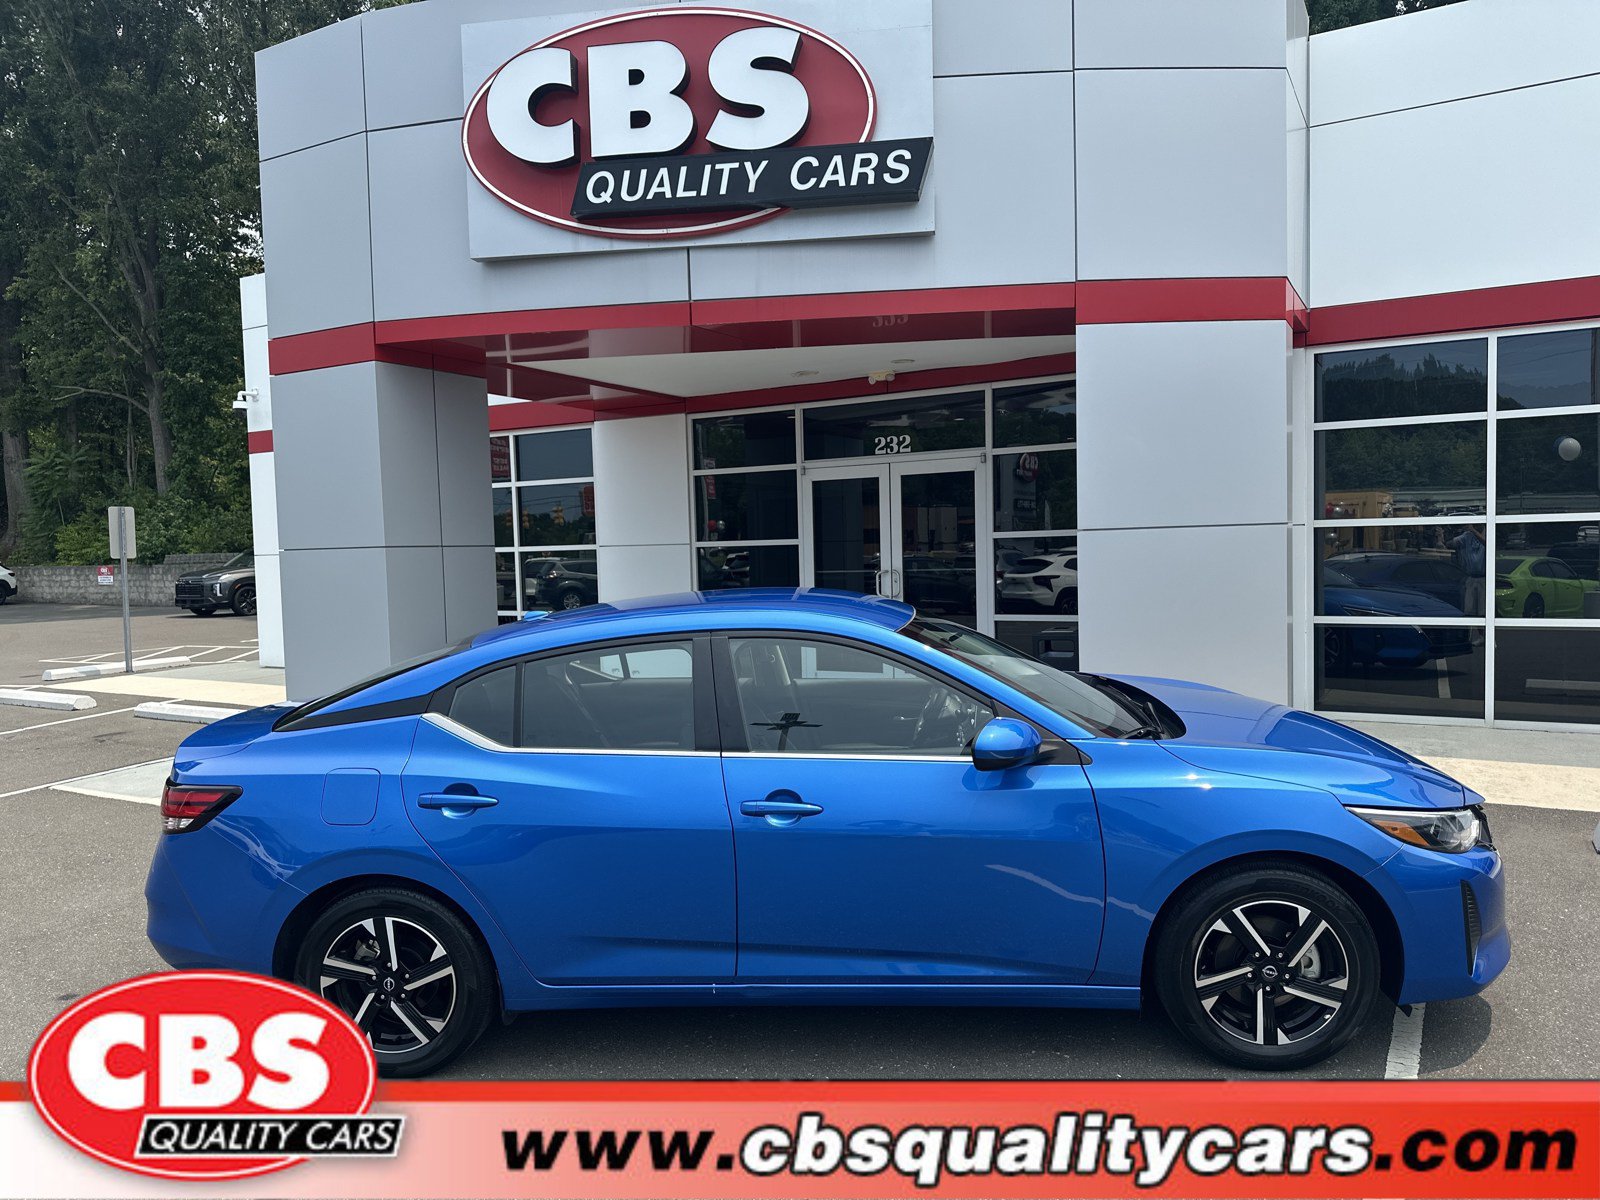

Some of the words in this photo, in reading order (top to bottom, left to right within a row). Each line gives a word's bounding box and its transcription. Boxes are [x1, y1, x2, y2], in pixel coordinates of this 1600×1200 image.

[486, 27, 810, 165] CBS
[585, 159, 769, 205] QUALITY
[789, 148, 912, 192] CARS
[874, 434, 912, 455] 232
